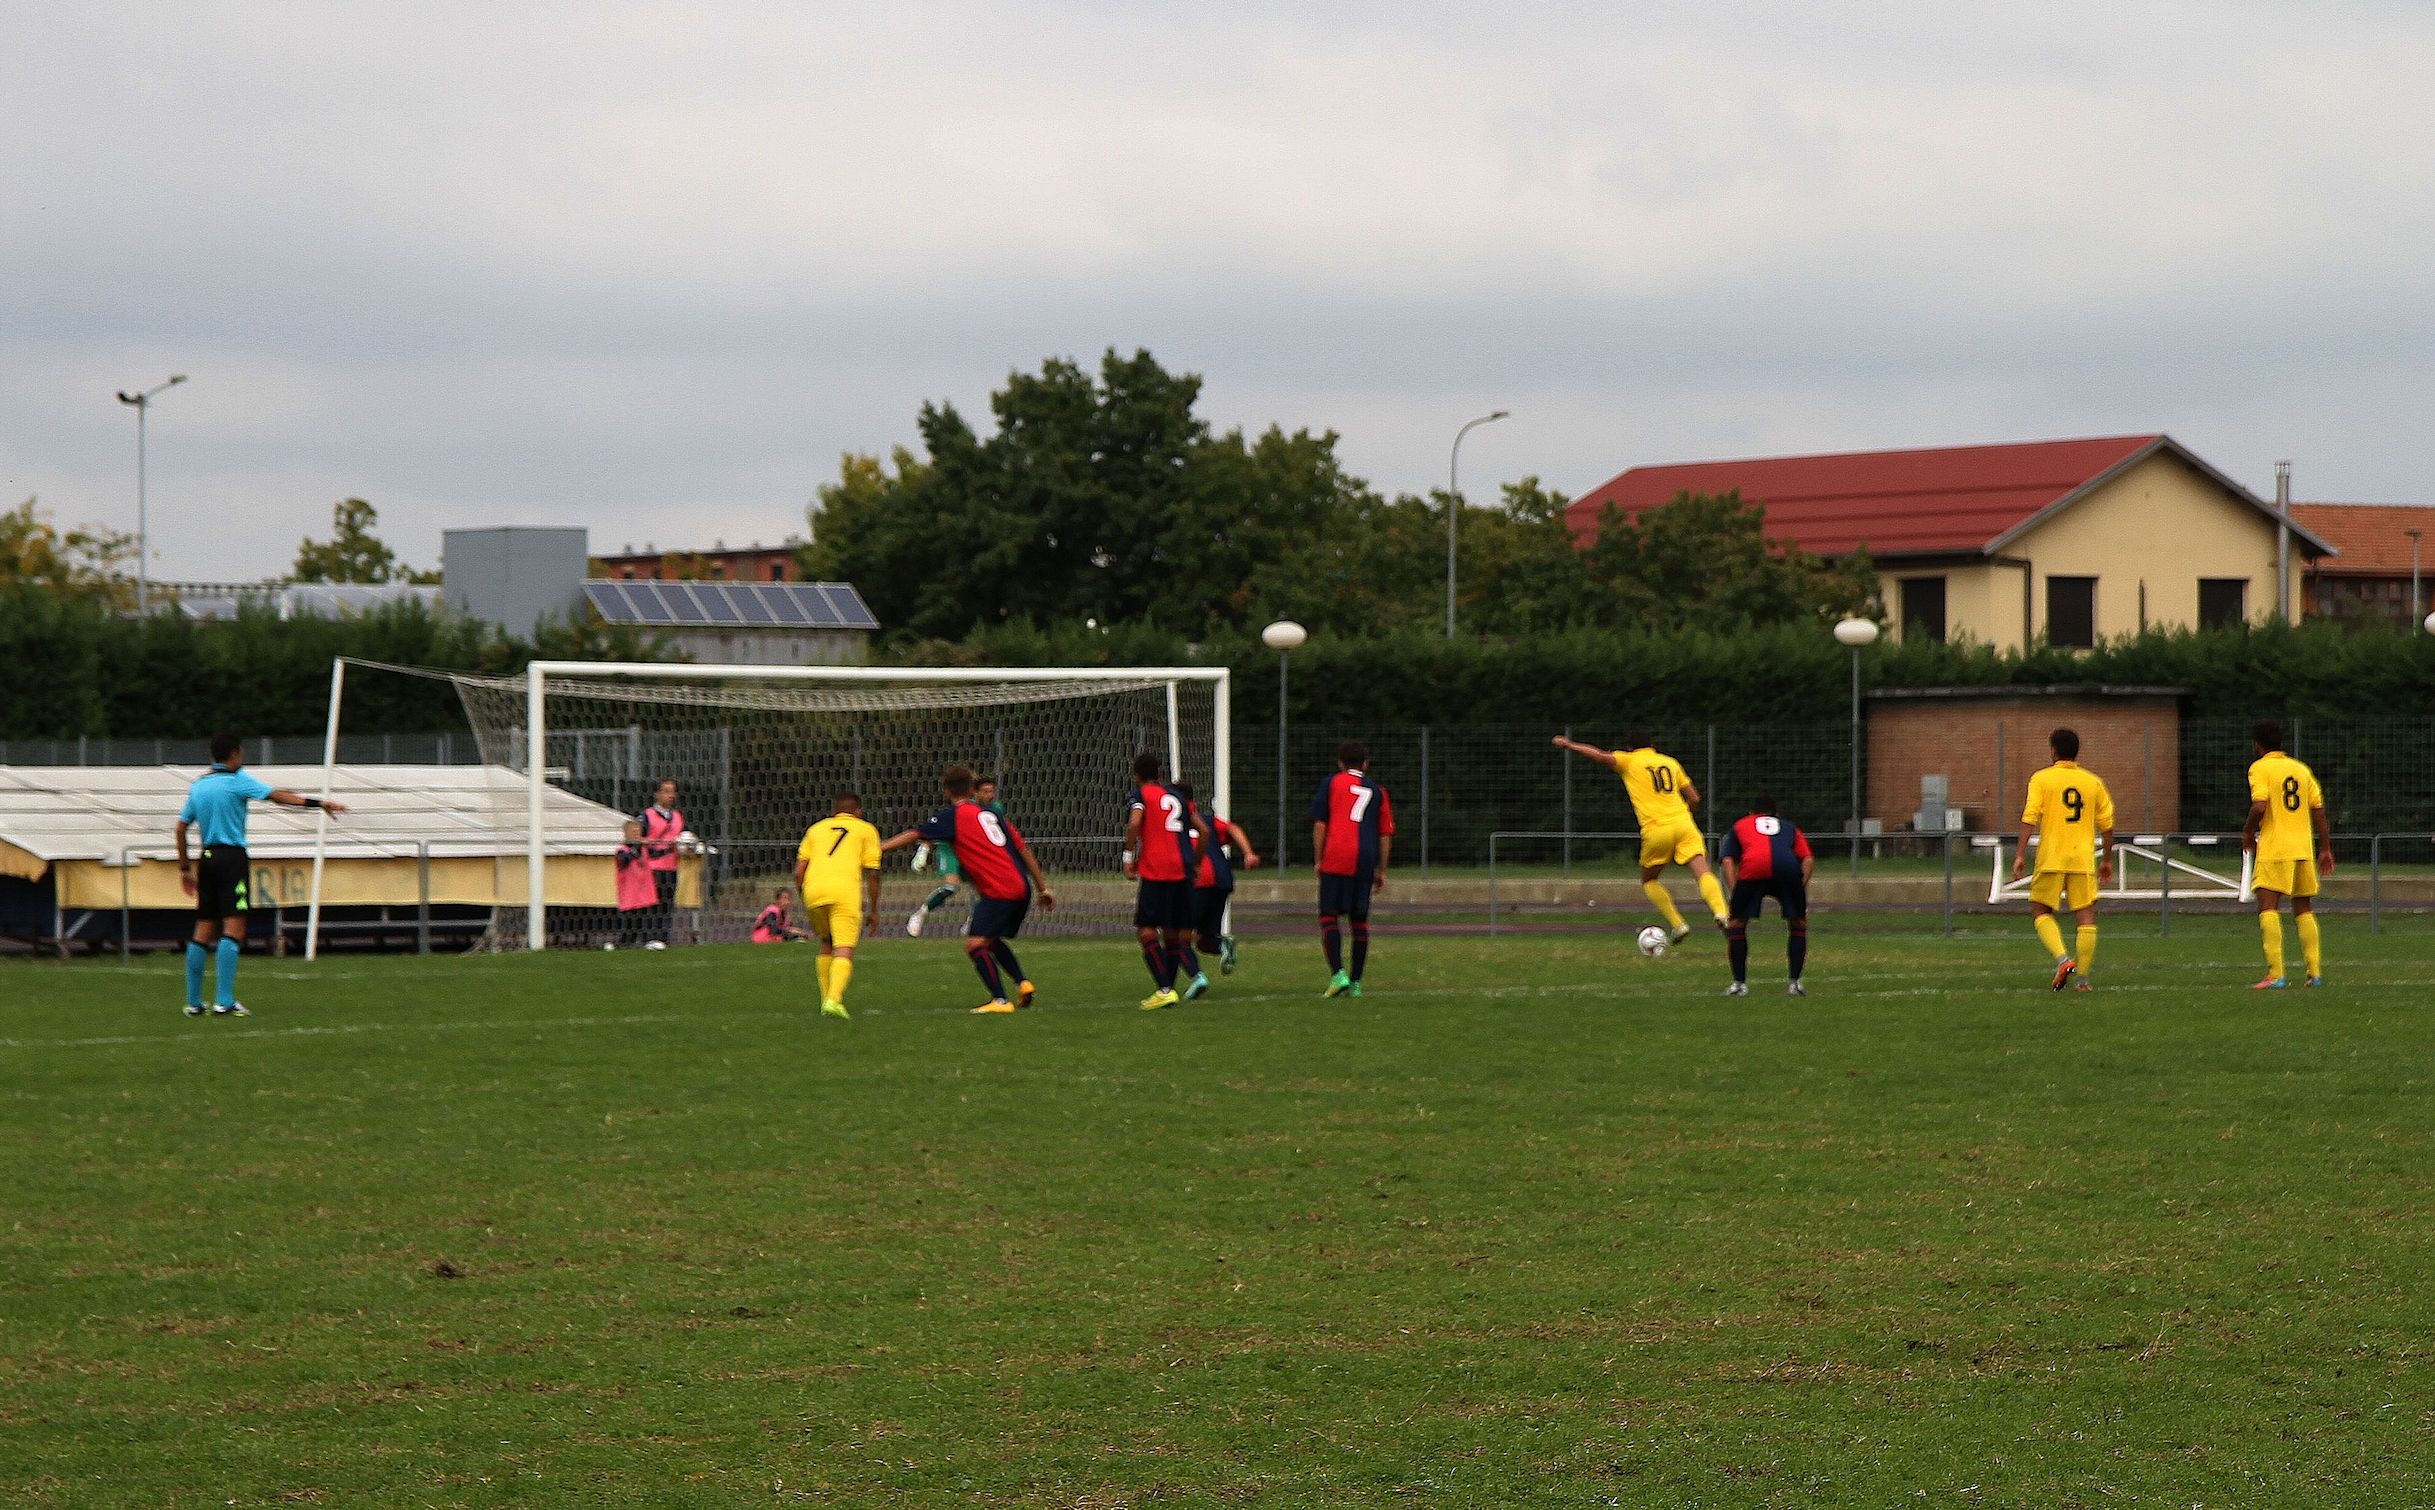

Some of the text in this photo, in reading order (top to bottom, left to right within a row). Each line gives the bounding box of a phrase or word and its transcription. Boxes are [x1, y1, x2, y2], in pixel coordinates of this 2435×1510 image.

[1645, 765, 1673, 793] 10
[2282, 776, 2300, 811] 8
[1160, 794, 1183, 832] 2
[1349, 784, 1373, 822] 7
[2062, 787, 2083, 823] 9
[828, 827, 848, 856] 7
[977, 810, 1007, 847] 6
